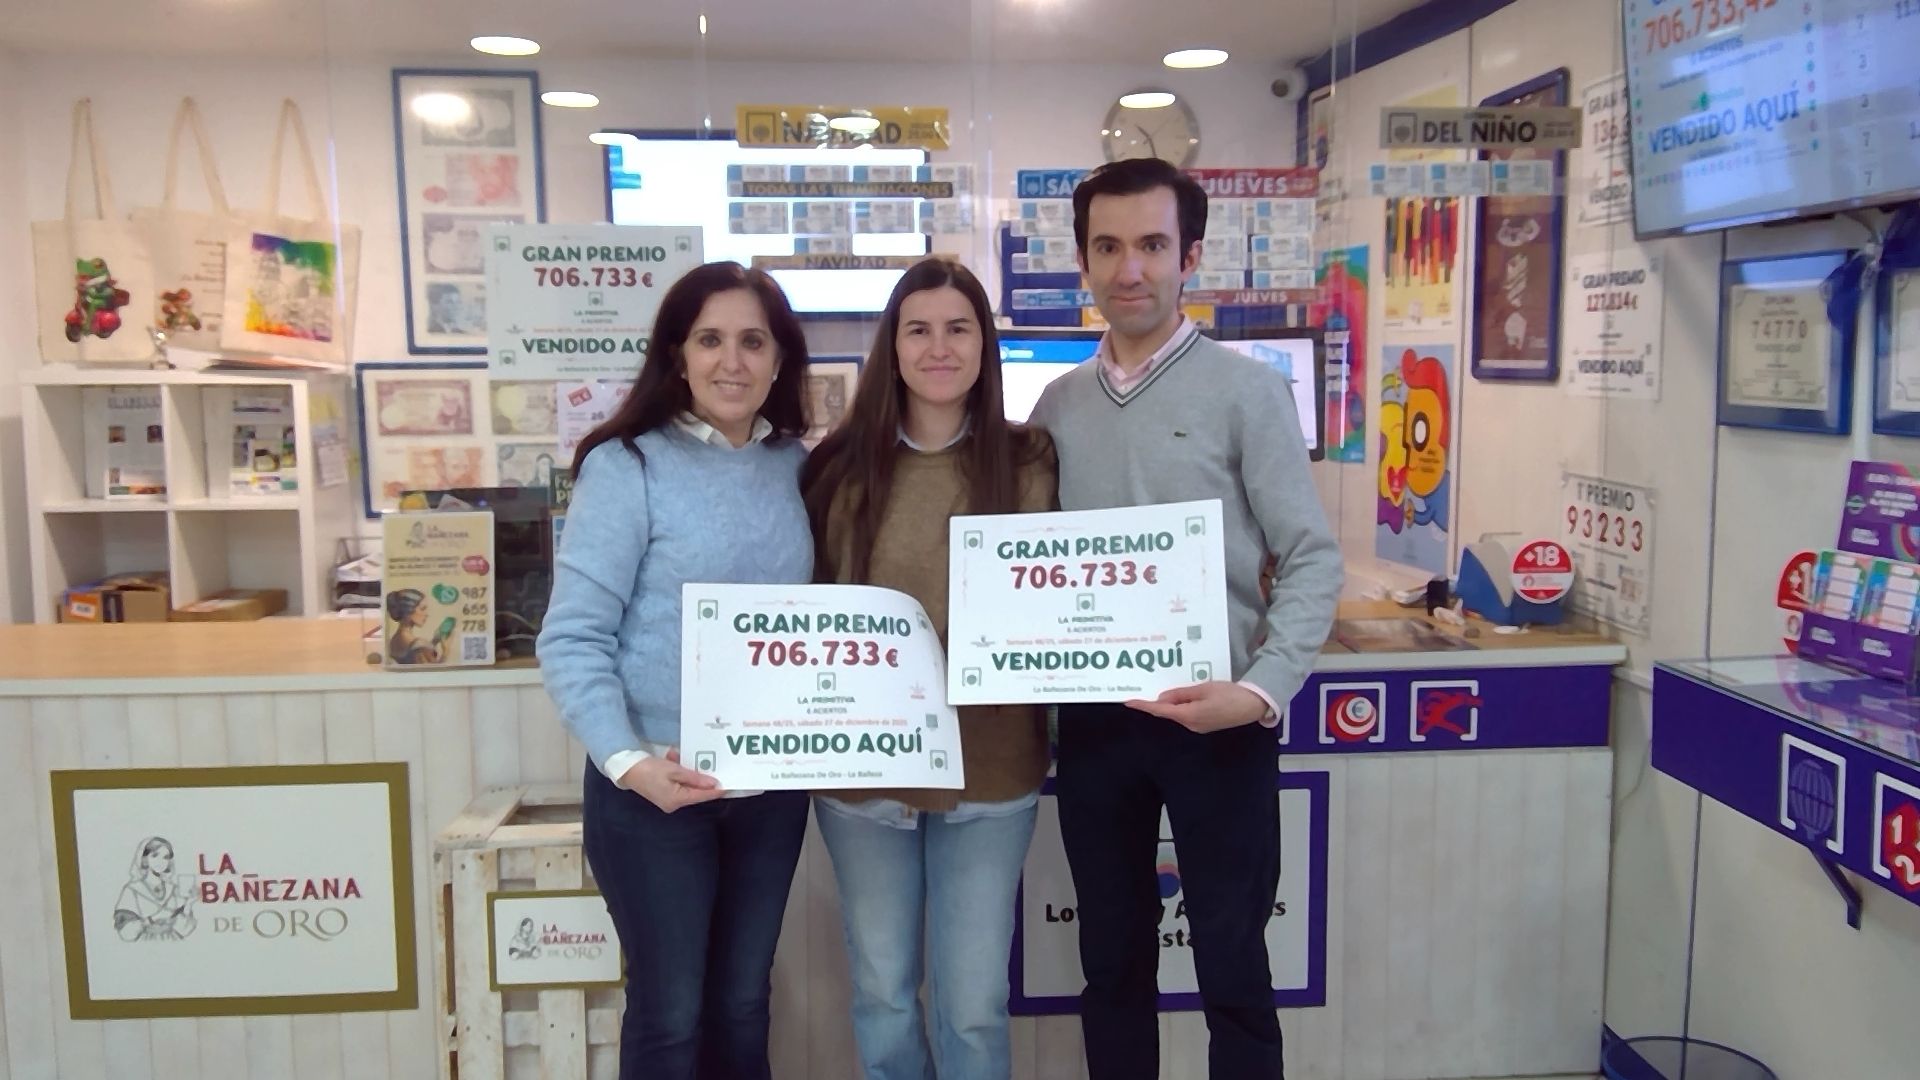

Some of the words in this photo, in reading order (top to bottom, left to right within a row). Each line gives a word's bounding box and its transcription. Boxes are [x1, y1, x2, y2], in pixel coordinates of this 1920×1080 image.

[1648, 108, 1736, 153] VENDIDO
[1744, 80, 1799, 132] AQUÍ
[1423, 120, 1464, 143] DEL
[1470, 114, 1537, 143] NIÑO
[749, 182, 796, 196] TODAS
[802, 182, 828, 196] LAS
[832, 182, 950, 197] TERMINACIONES
[1205, 176, 1287, 194] JUEVES
[522, 245, 581, 262] GRAN
[586, 245, 666, 262] PREMIO
[805, 256, 887, 269] NAVIDAD
[1233, 291, 1288, 303] JUEVES
[522, 337, 616, 354] VENDIDO
[621, 337, 651, 354] AQ
[1587, 484, 1636, 512] PREMIO
[1567, 504, 1643, 552] 93233
[996, 539, 1070, 560] GRAN
[1075, 531, 1174, 557] PREMIO
[1524, 545, 1561, 567] +18
[461, 587, 487, 599] 987
[462, 604, 488, 616] 655
[462, 620, 487, 632] 778
[733, 612, 811, 634] GRAN
[816, 612, 911, 637] PREMIO
[991, 650, 1110, 671] VENDIDO
[1115, 640, 1182, 673] AQUÍ
[797, 696, 809, 704] LA
[811, 695, 856, 704] PRIMITIVA
[812, 706, 848, 714] ACIERTOS
[845, 718, 880, 727] diciembre
[726, 733, 850, 755] VENDIDO
[857, 727, 923, 757] AQUÍ
[1891, 814, 1903, 845] 1
[199, 853, 236, 876] LA
[1895, 855, 1920, 885] 2
[201, 873, 361, 904] BAÑEZANA
[213, 916, 244, 933] DE
[252, 907, 349, 942] ORO
[542, 923, 559, 934] LA
[542, 931, 608, 945] BAÑEZANA
[563, 945, 602, 960] ORO
